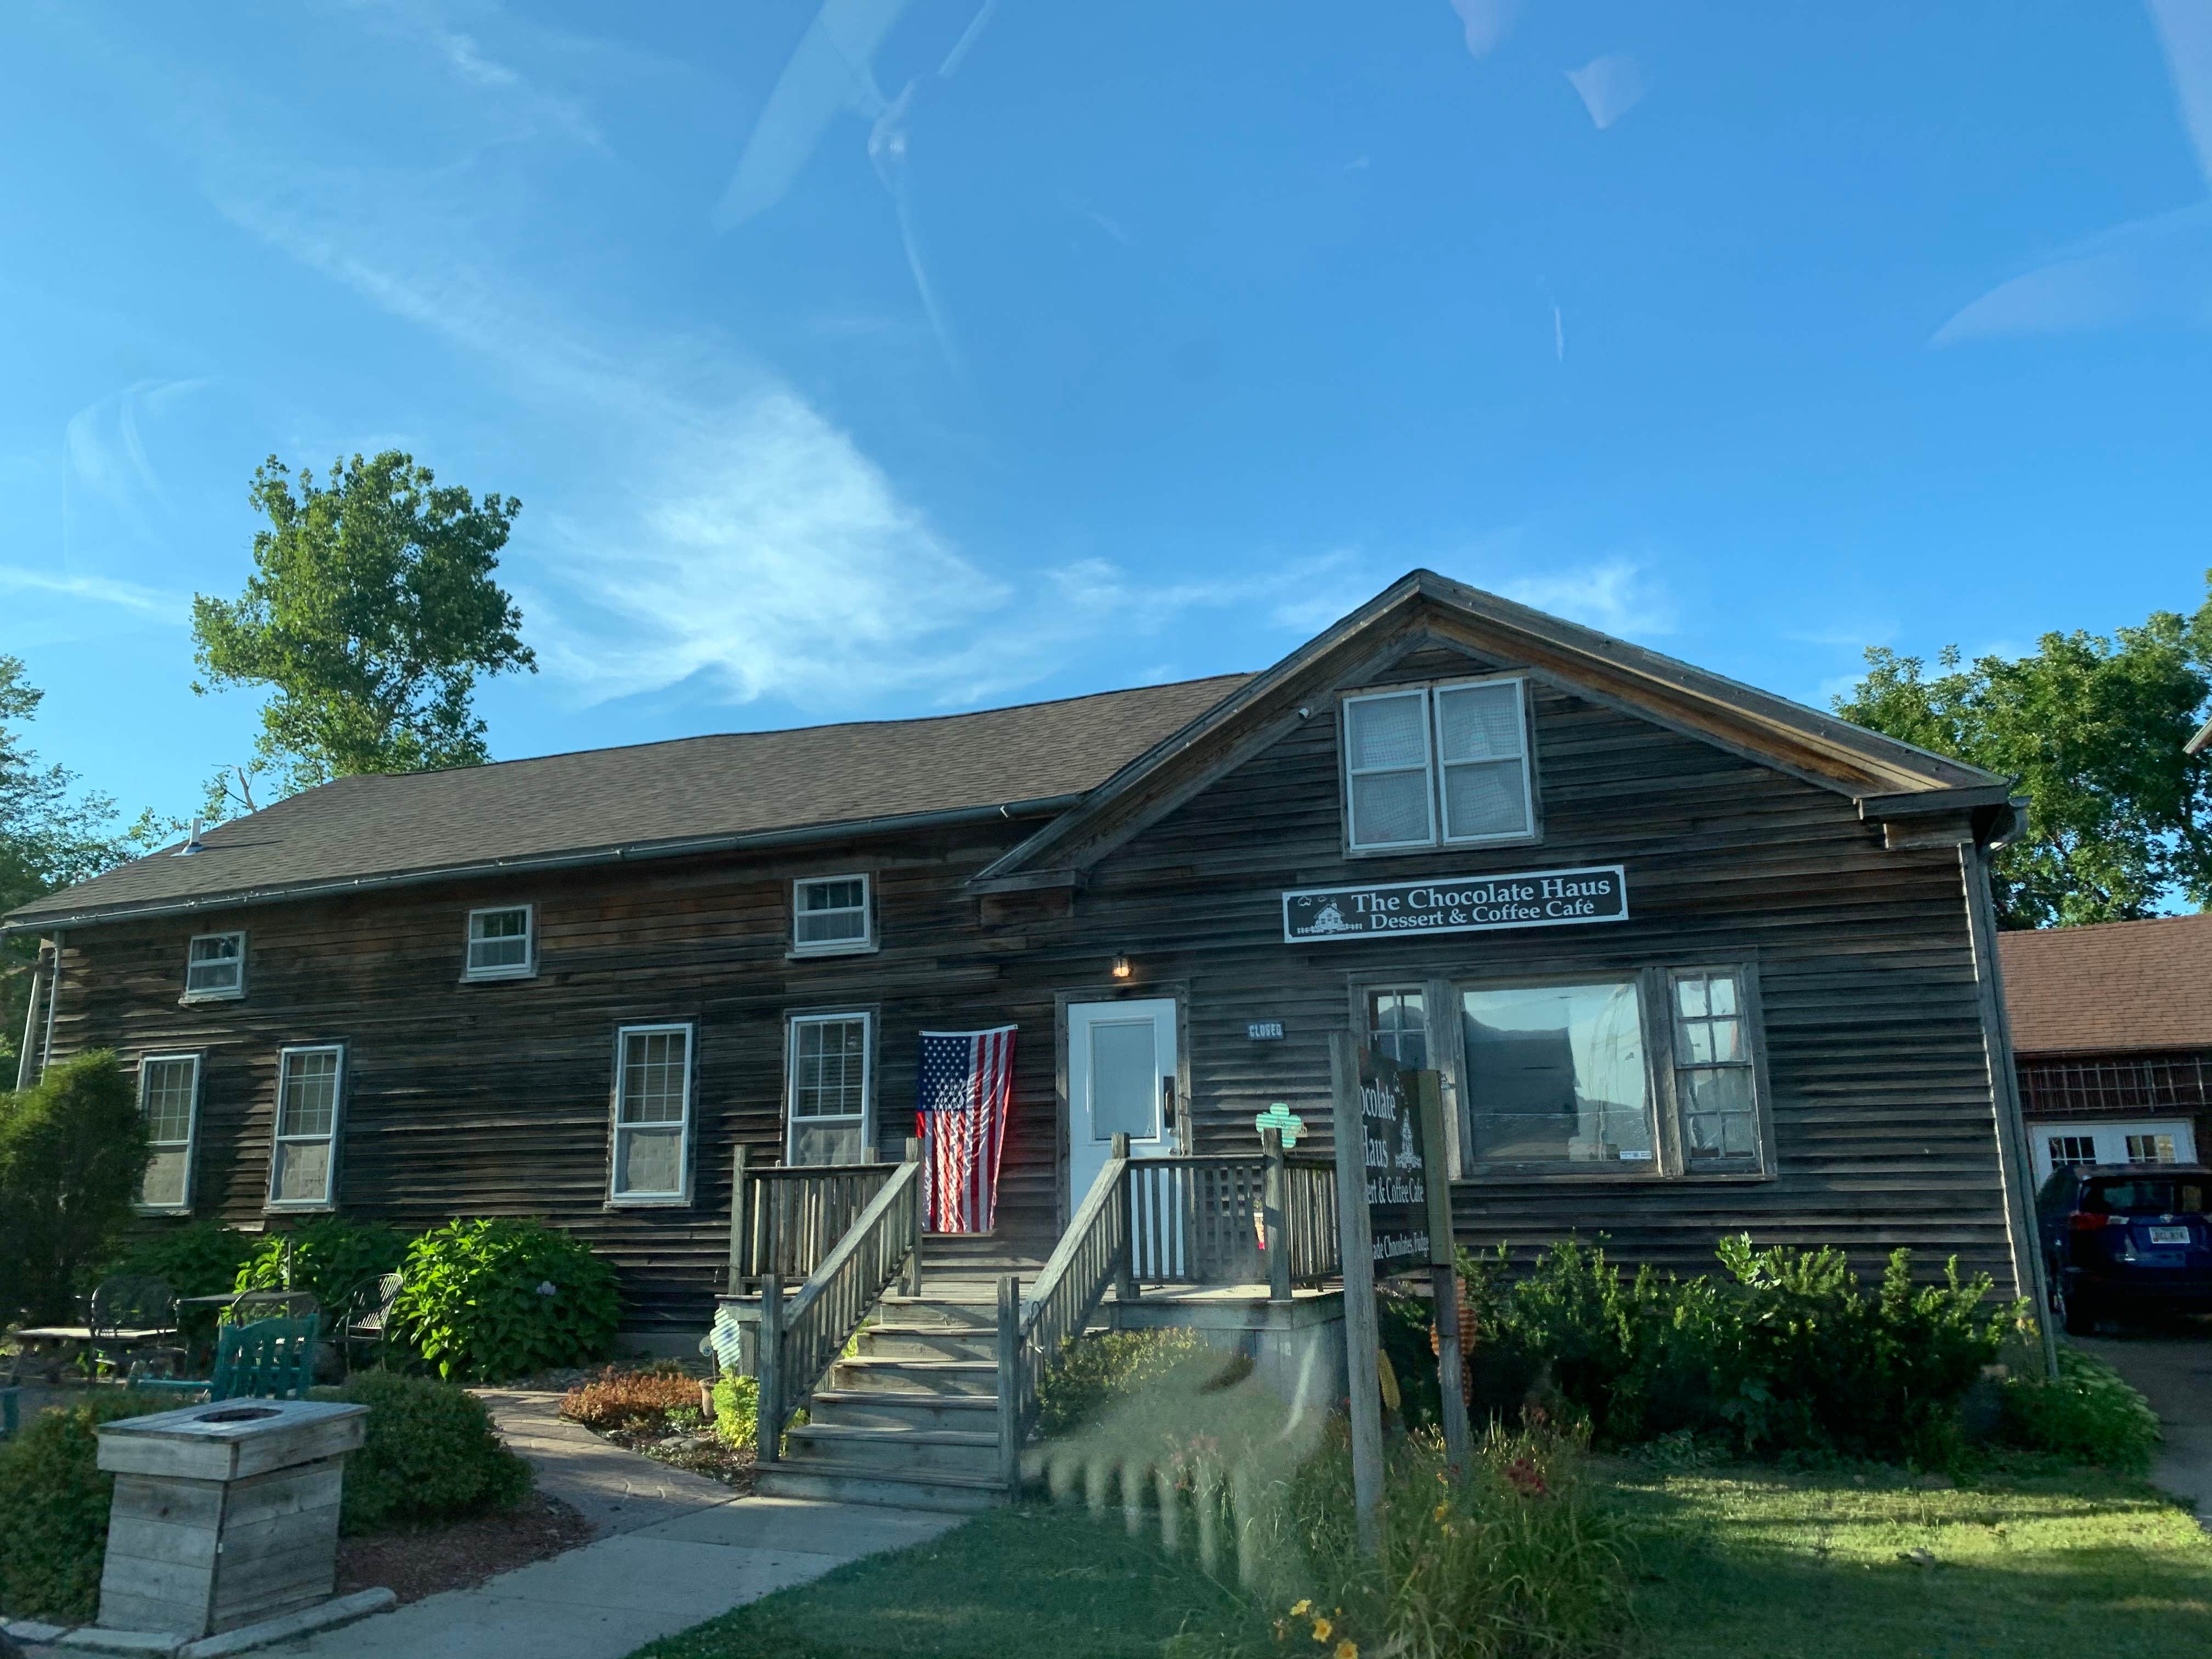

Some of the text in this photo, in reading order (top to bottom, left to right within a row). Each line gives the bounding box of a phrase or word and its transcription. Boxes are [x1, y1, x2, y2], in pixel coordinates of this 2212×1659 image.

[1351, 879, 1611, 913] The Chocolate Haus
[1370, 899, 1594, 929] Dessert & Coffee Café
[1250, 1023, 1282, 1036] CLOSED
[1361, 1077, 1396, 1121] ocolate
[1386, 1176, 1408, 1203] Coffee
